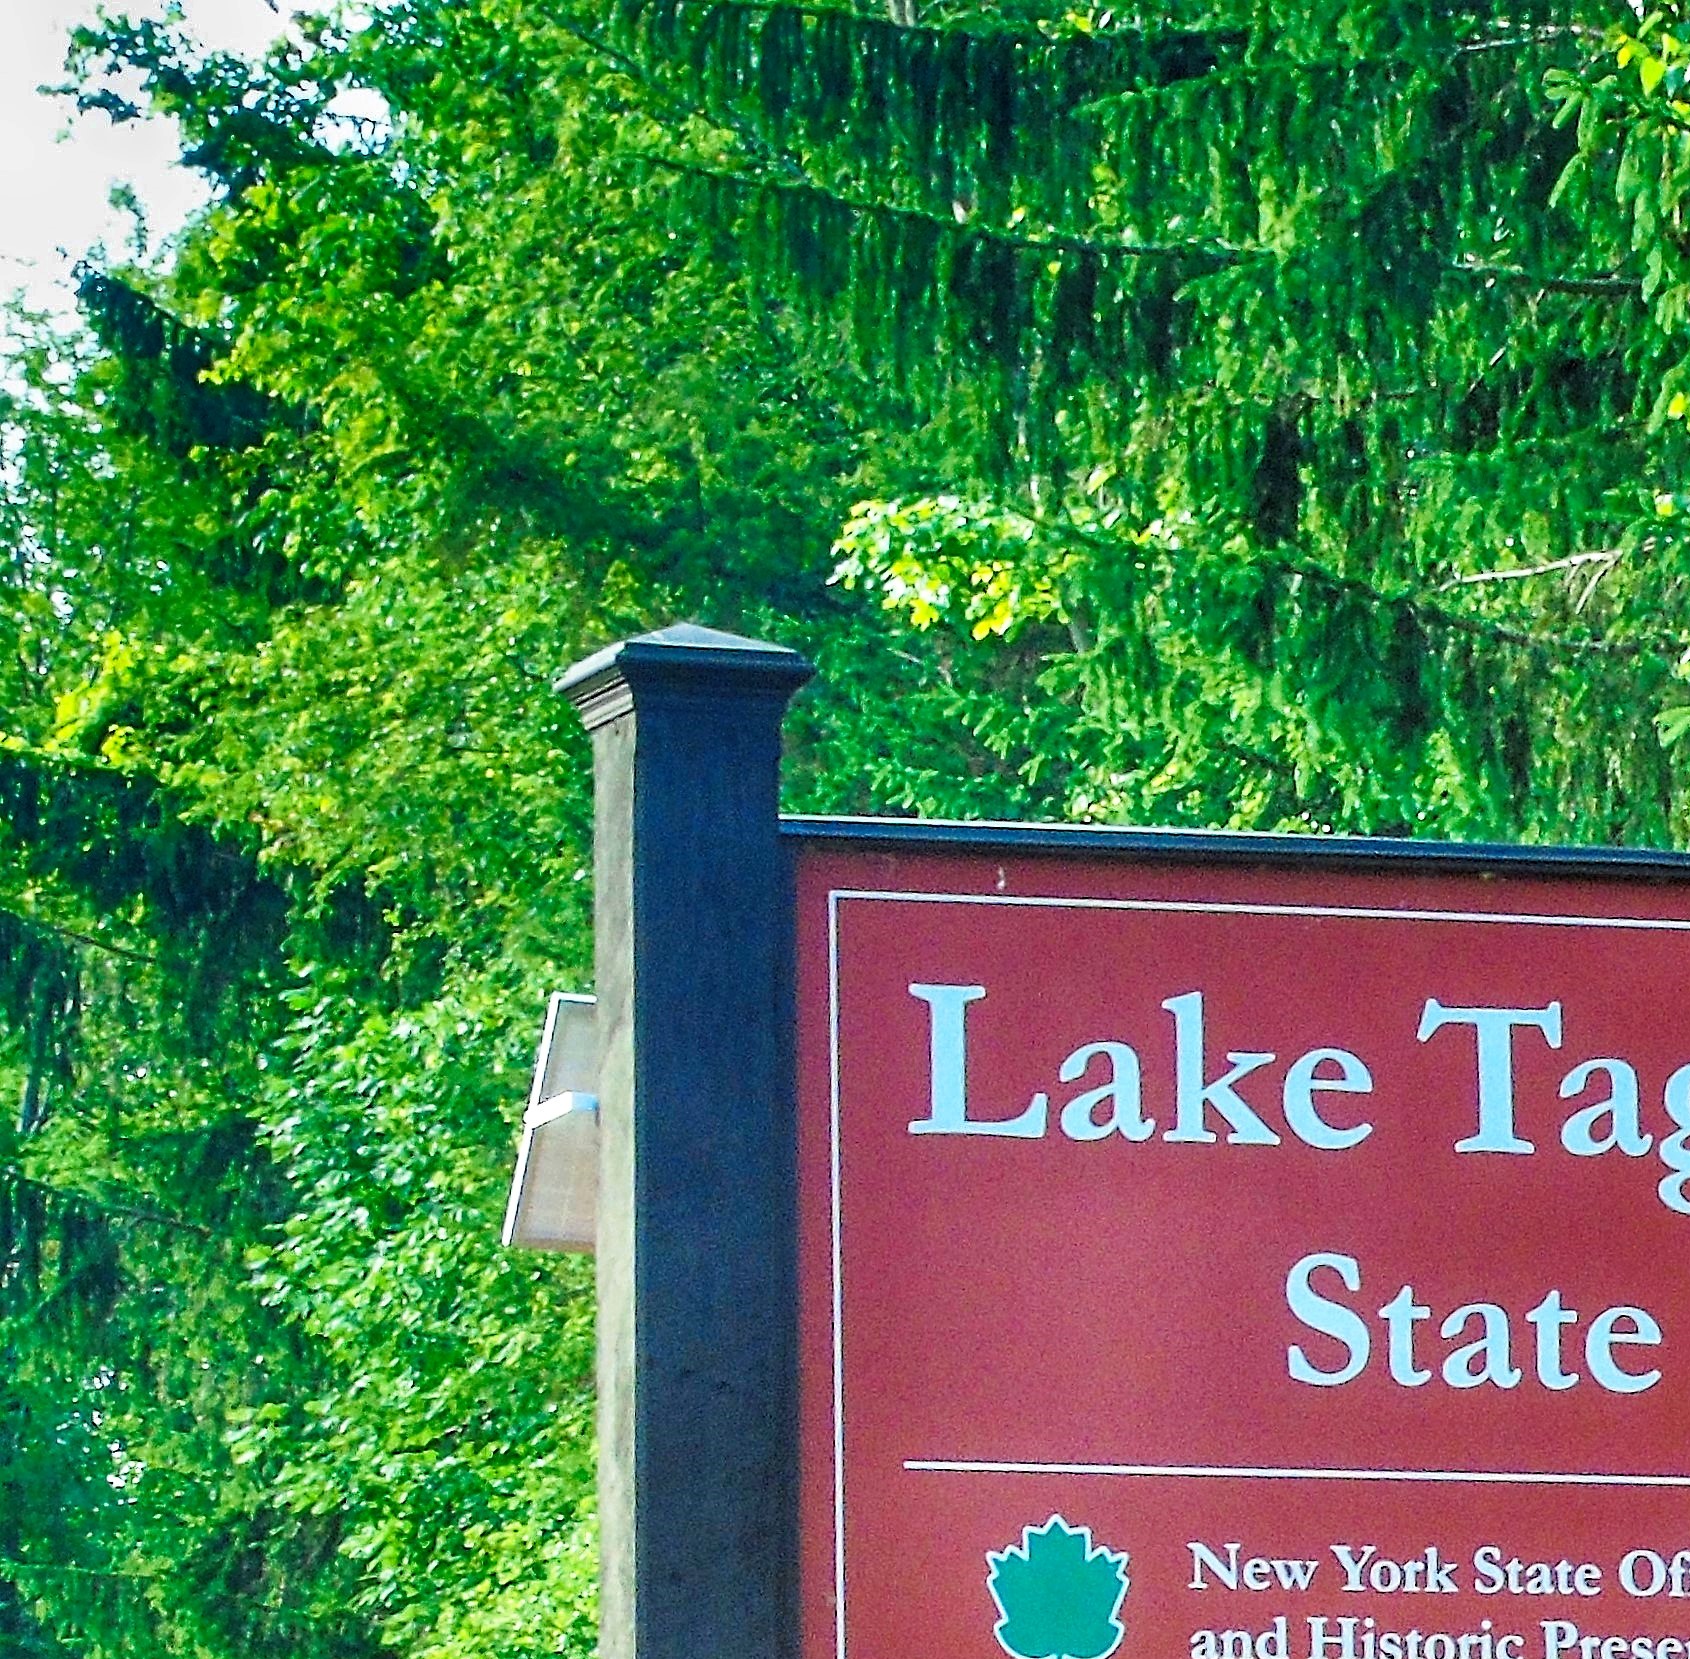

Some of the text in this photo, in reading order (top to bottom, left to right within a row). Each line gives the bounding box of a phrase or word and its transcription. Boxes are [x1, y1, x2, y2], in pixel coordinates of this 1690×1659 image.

[908, 984, 1373, 1149] Lake
[1286, 1253, 1661, 1395] State
[1187, 1542, 1318, 1592] New
[1331, 1543, 1459, 1595] York
[1472, 1547, 1602, 1599] State
